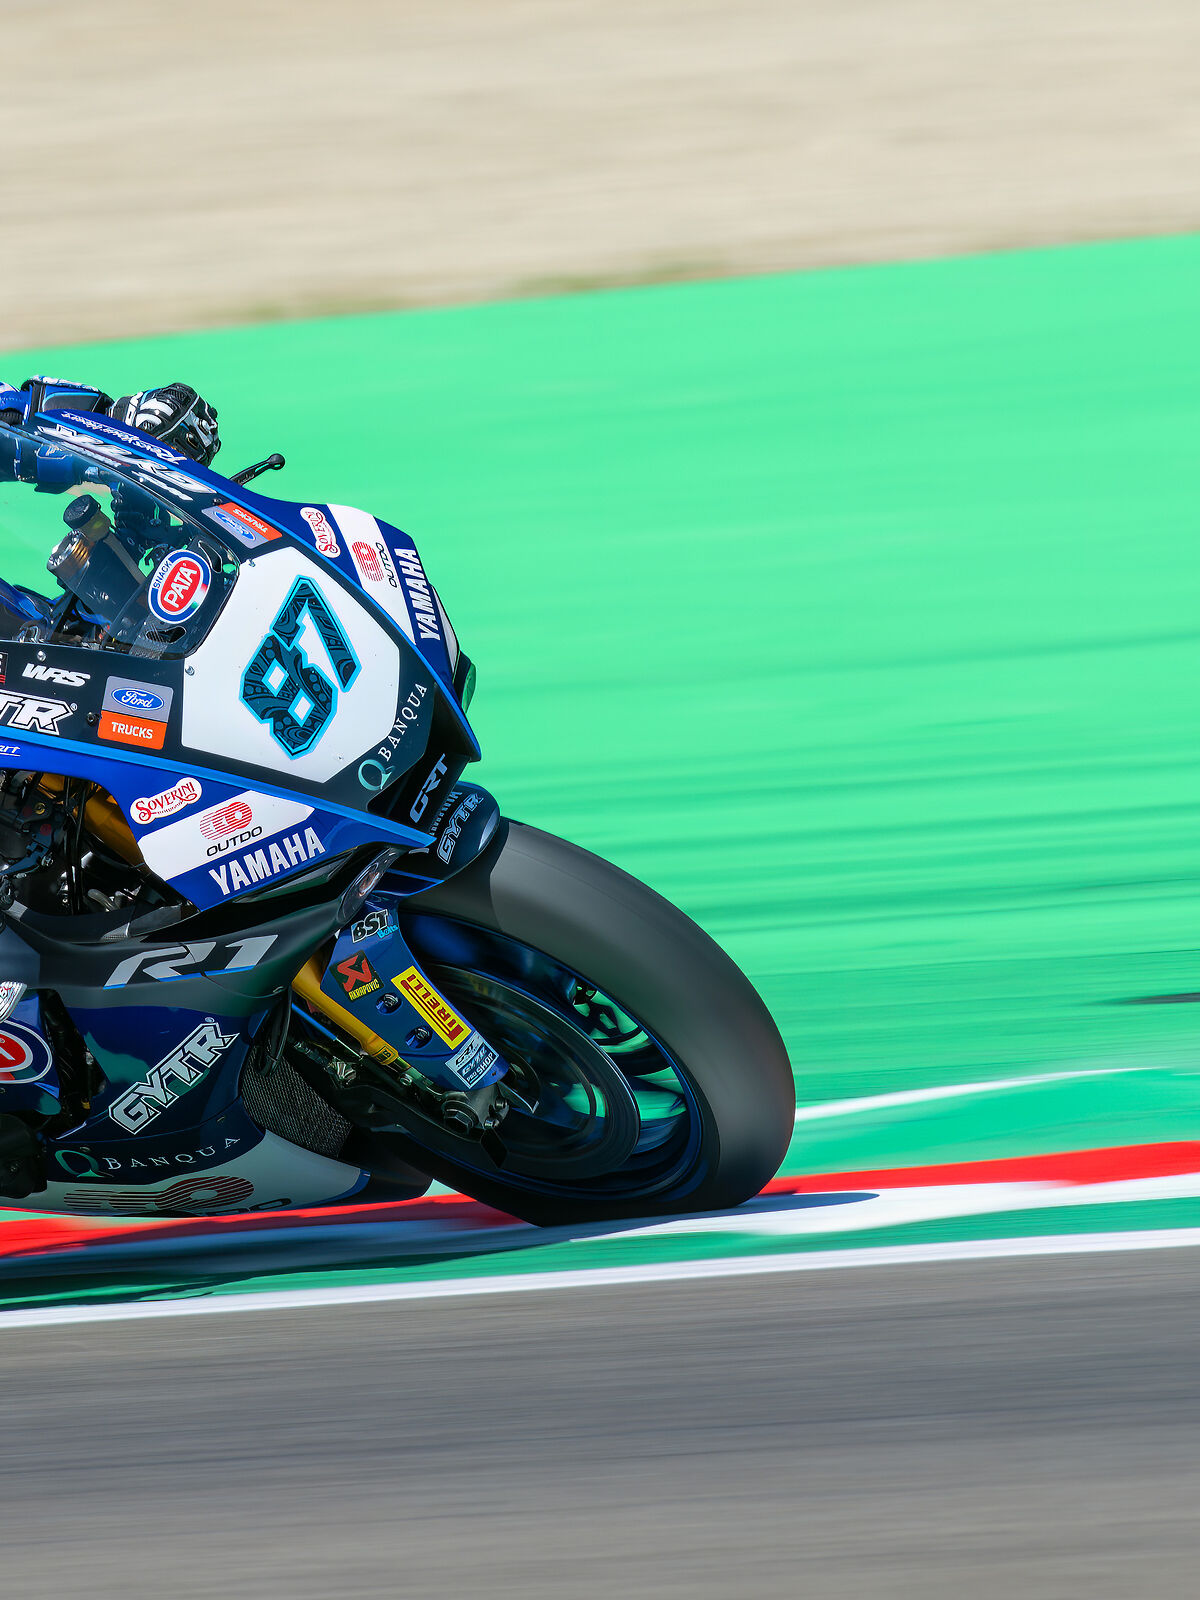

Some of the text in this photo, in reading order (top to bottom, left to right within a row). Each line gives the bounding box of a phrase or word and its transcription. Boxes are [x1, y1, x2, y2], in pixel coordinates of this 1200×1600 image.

[164, 566, 197, 608] PATA
[376, 542, 397, 588] OUTDO
[394, 548, 440, 640] YAMAHA
[21, 663, 91, 687] WRS
[239, 575, 361, 760] 87
[120, 690, 153, 709] Ford
[378, 682, 427, 762] BANQUA
[111, 721, 154, 740] TRUCKS
[136, 782, 197, 821] SOVERINI
[207, 826, 262, 856] OUTDO
[437, 793, 484, 864] GYTR
[209, 827, 326, 895] YAMAHA
[351, 909, 390, 943] BST
[103, 934, 278, 990] R1
[400, 974, 465, 1043] PIRELLI
[107, 1021, 240, 1135] GYTR
[103, 1135, 241, 1170] BANQUA
